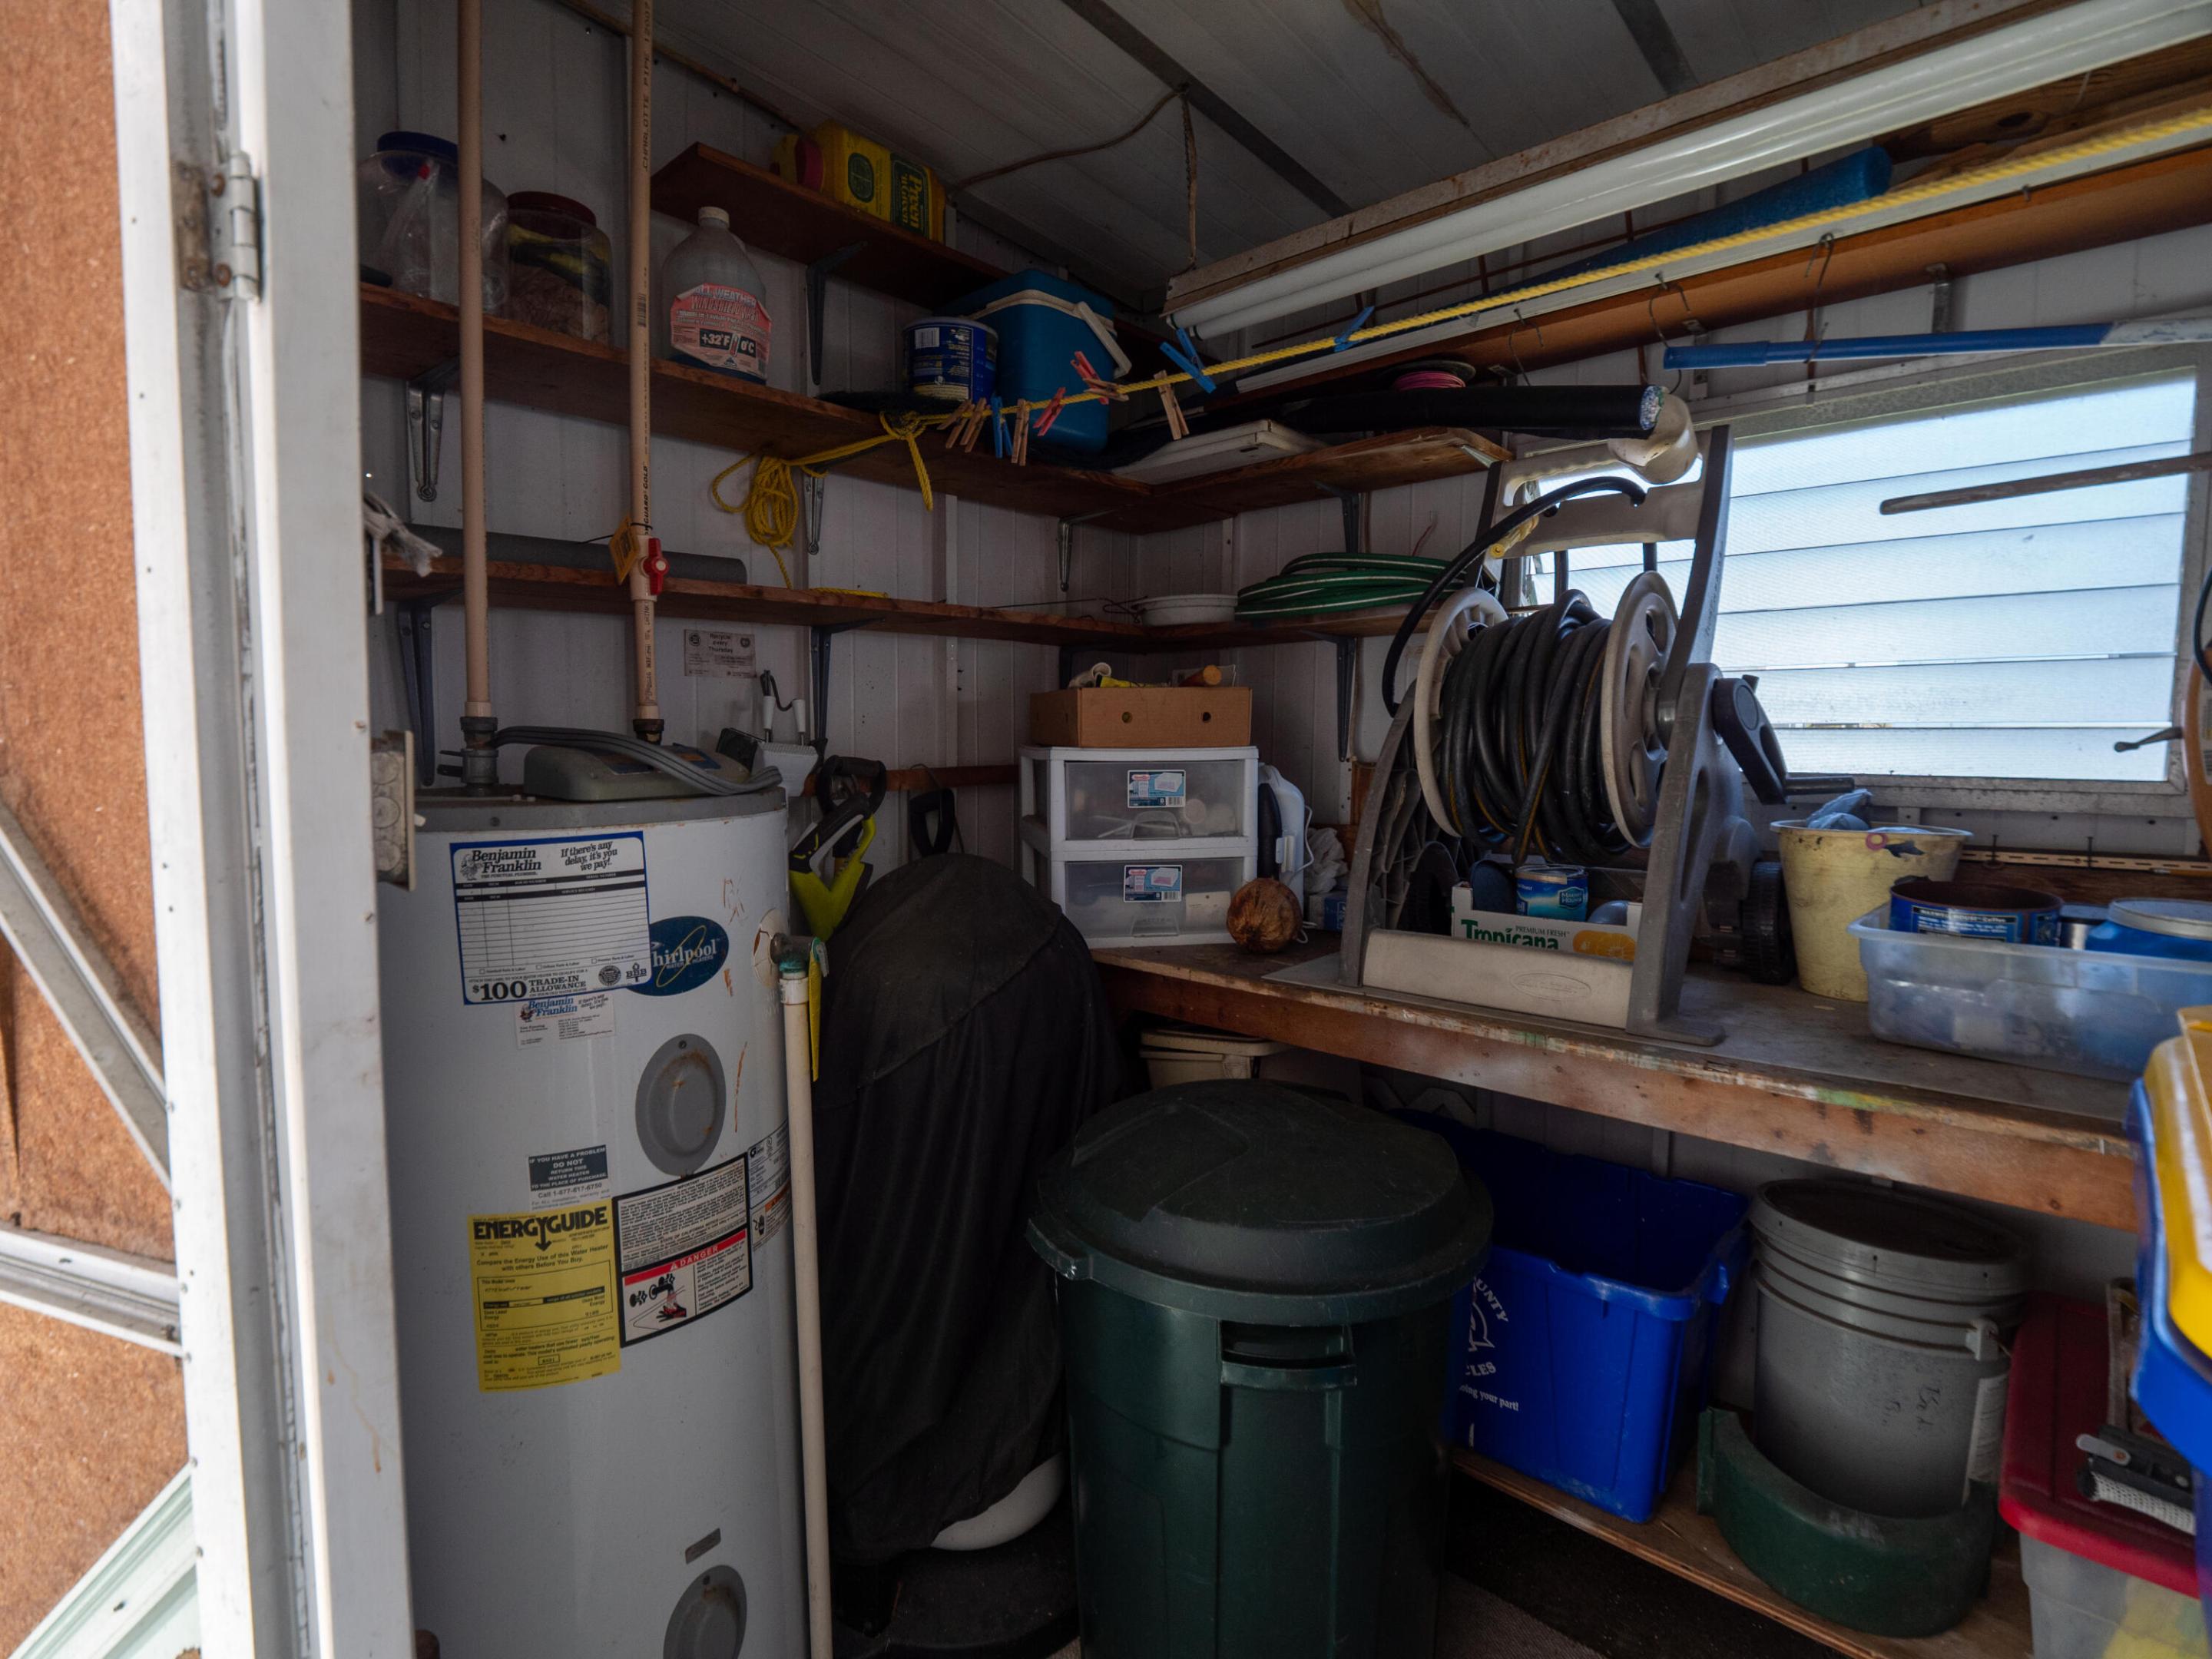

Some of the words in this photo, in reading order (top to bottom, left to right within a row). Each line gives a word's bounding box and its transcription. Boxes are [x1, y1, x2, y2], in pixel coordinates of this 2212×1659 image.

[472, 847, 536, 864] Benjamin
[561, 848, 569, 858] If
[569, 843, 597, 856] there's
[598, 841, 614, 850] any
[565, 856, 588, 866] delay,
[589, 851, 601, 861] it's
[602, 849, 618, 859] you
[482, 859, 541, 873] Franklin
[580, 863, 592, 871] we
[1515, 926, 1545, 935] PREMIUM
[1547, 929, 1566, 938] FRESH
[626, 969, 647, 978] BBB
[528, 975, 580, 987] TRADE-IN
[529, 981, 587, 994] ALLOWANCE
[472, 980, 528, 1001] $100
[528, 996, 574, 1009] Benjamin
[535, 1005, 578, 1016] Franklin
[576, 1147, 606, 1157] PROBLEM
[473, 1207, 608, 1240] ENERGYGUIDE
[680, 1245, 719, 1267] DANGER
[1479, 1390, 1498, 1405] your
